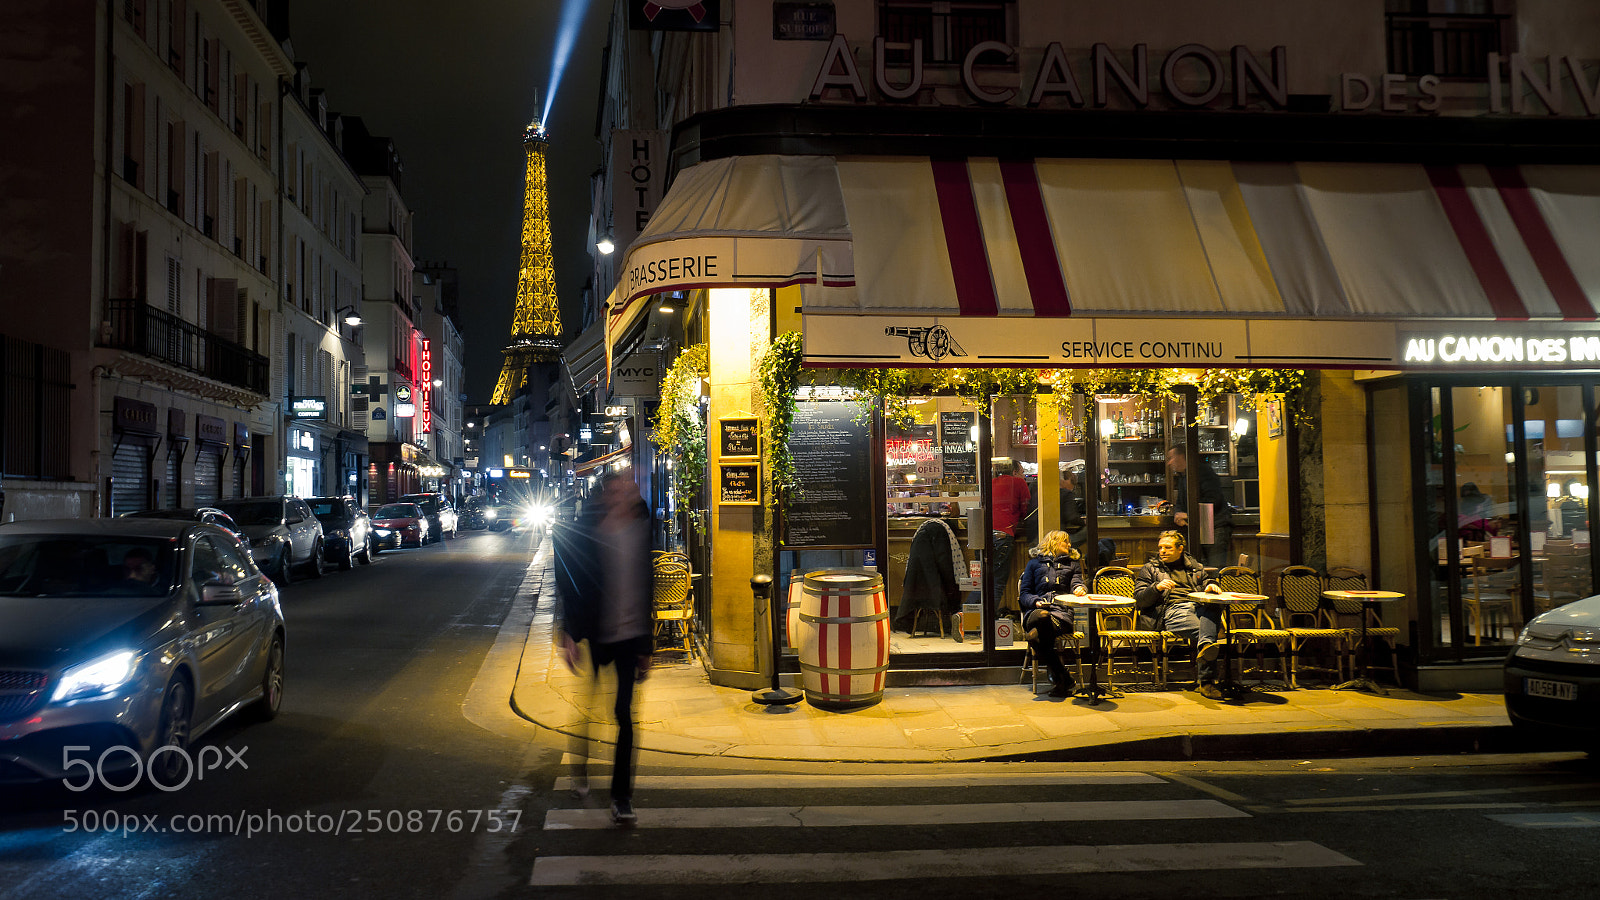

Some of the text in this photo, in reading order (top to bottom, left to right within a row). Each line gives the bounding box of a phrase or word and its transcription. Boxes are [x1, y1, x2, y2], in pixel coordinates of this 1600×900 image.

[808, 33, 925, 102] AU
[959, 40, 1290, 110] CANON
[1340, 73, 1442, 113] DES
[630, 255, 718, 291] BRASSERIE
[1061, 341, 1223, 359] SERVICE CONTINU
[1405, 338, 1435, 362] AU
[1438, 335, 1524, 362] CANON
[1527, 338, 1567, 363] DES
[421, 339, 432, 432] THOUMIEUX
[617, 367, 654, 377] MYC
[917, 466, 940, 474] OPEN
